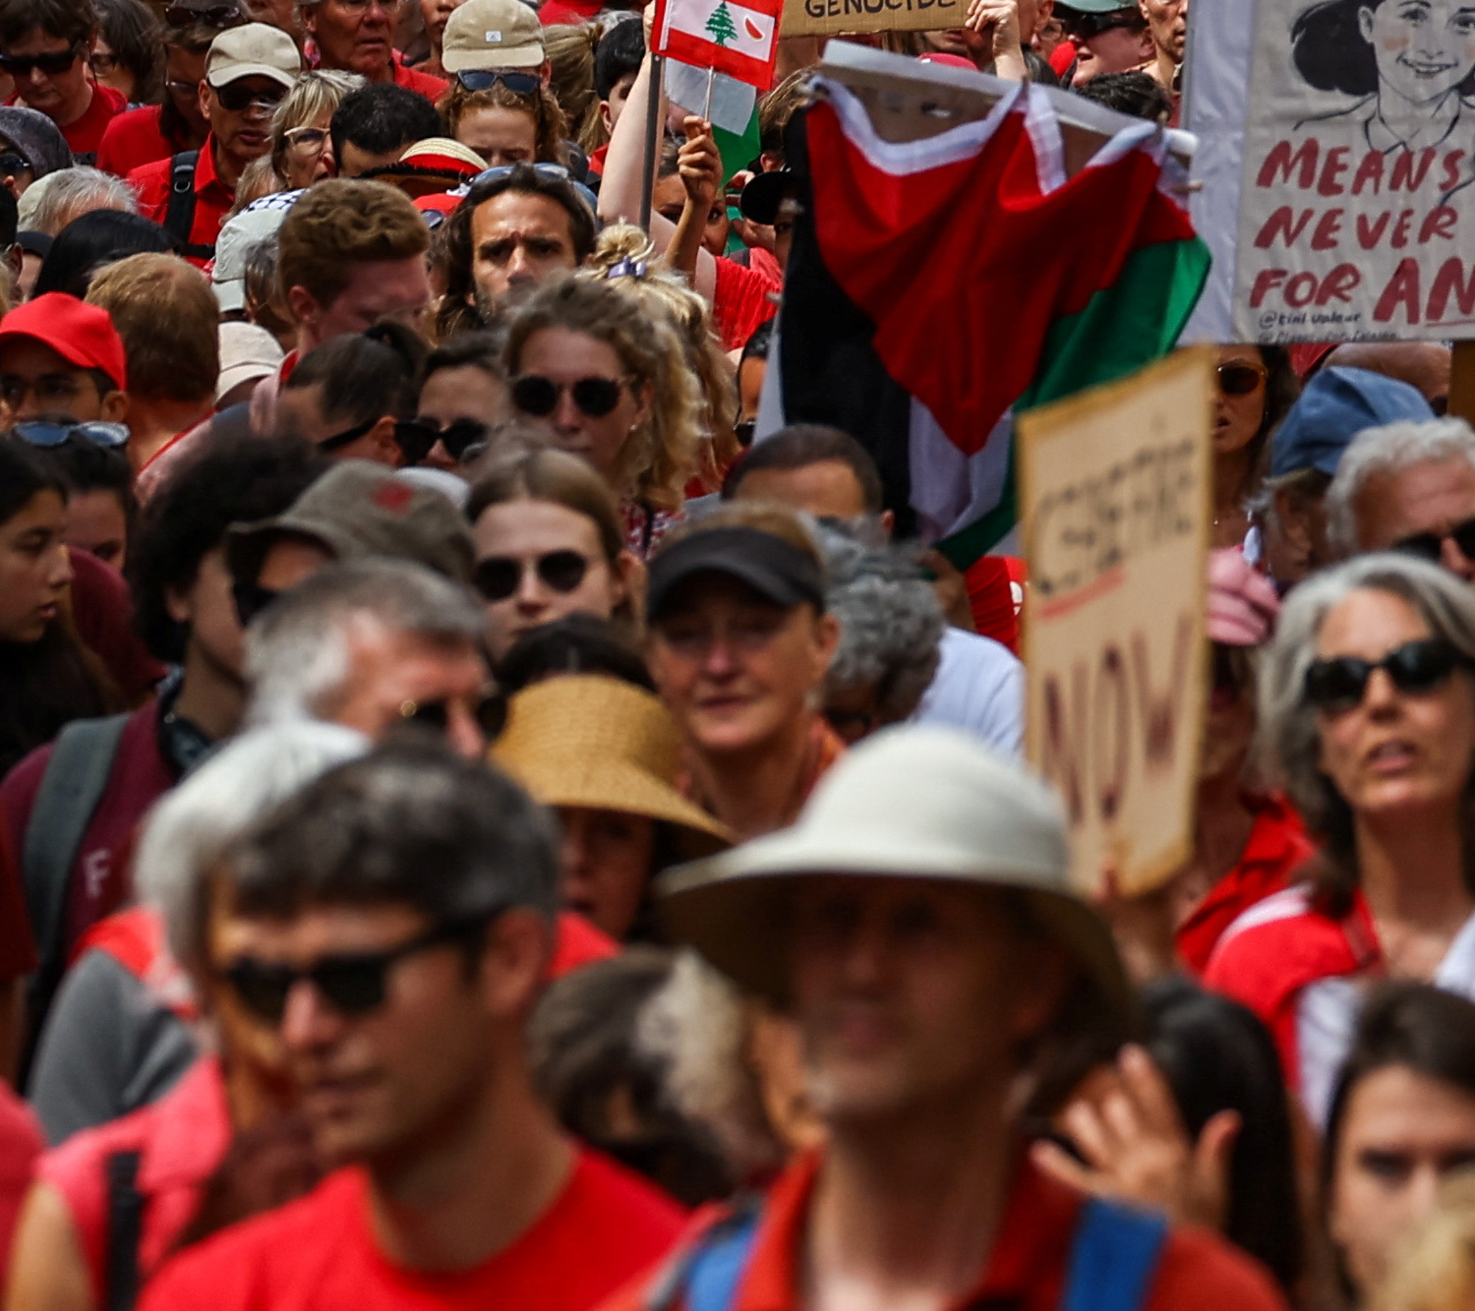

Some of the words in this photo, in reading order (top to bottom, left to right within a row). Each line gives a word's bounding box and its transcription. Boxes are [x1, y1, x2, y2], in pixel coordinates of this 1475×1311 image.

[1256, 137, 1466, 198] MEANS
[1253, 205, 1458, 251] NEVER
[1249, 262, 1362, 309] FOR
[1040, 612, 1194, 832] NOW
